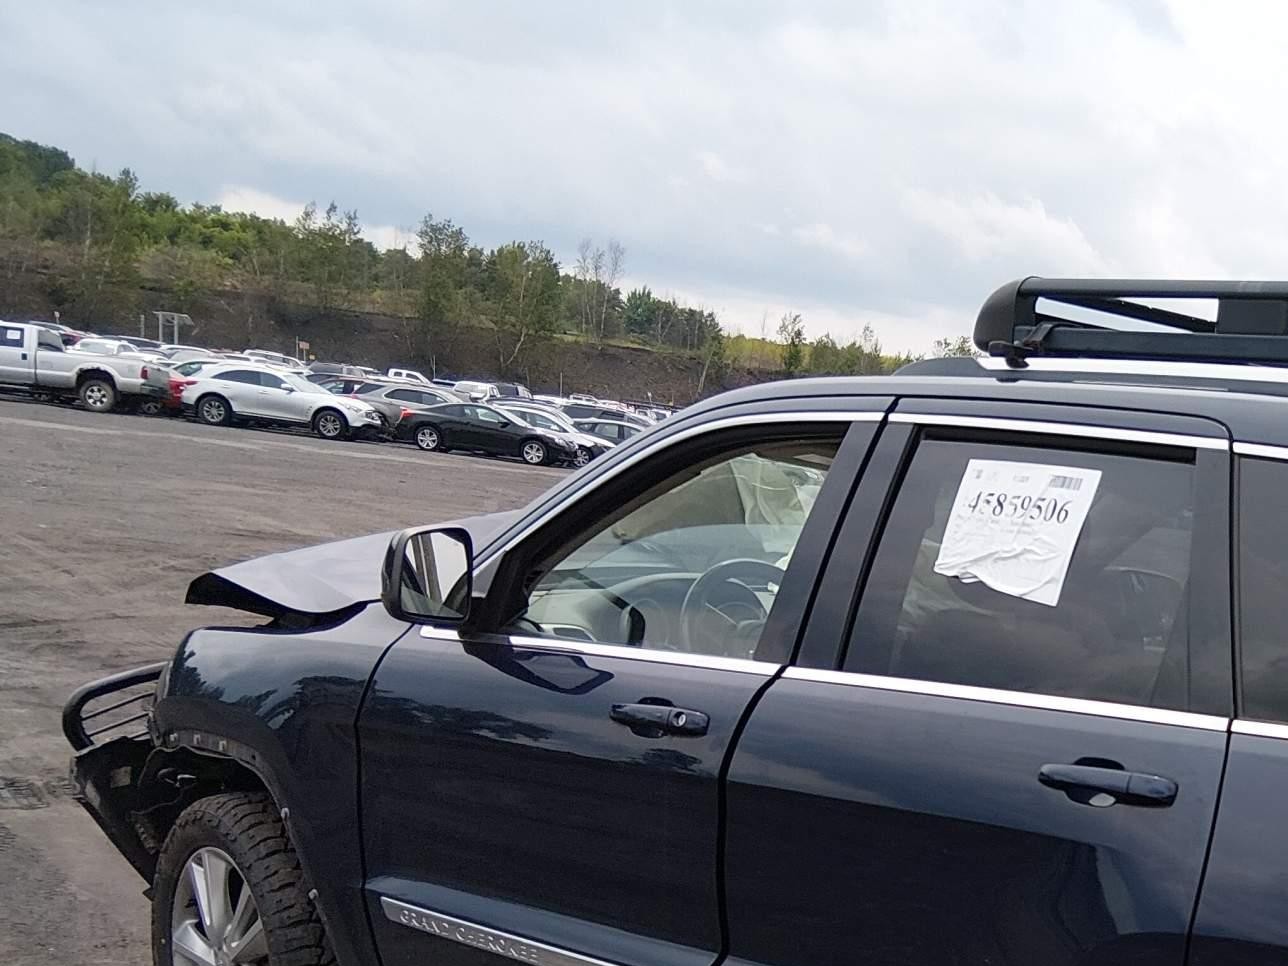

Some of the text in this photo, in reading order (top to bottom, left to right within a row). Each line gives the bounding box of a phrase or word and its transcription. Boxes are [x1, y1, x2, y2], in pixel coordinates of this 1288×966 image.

[967, 490, 1073, 524] 45859506
[399, 910, 539, 963] GRAND CHEROKEE
